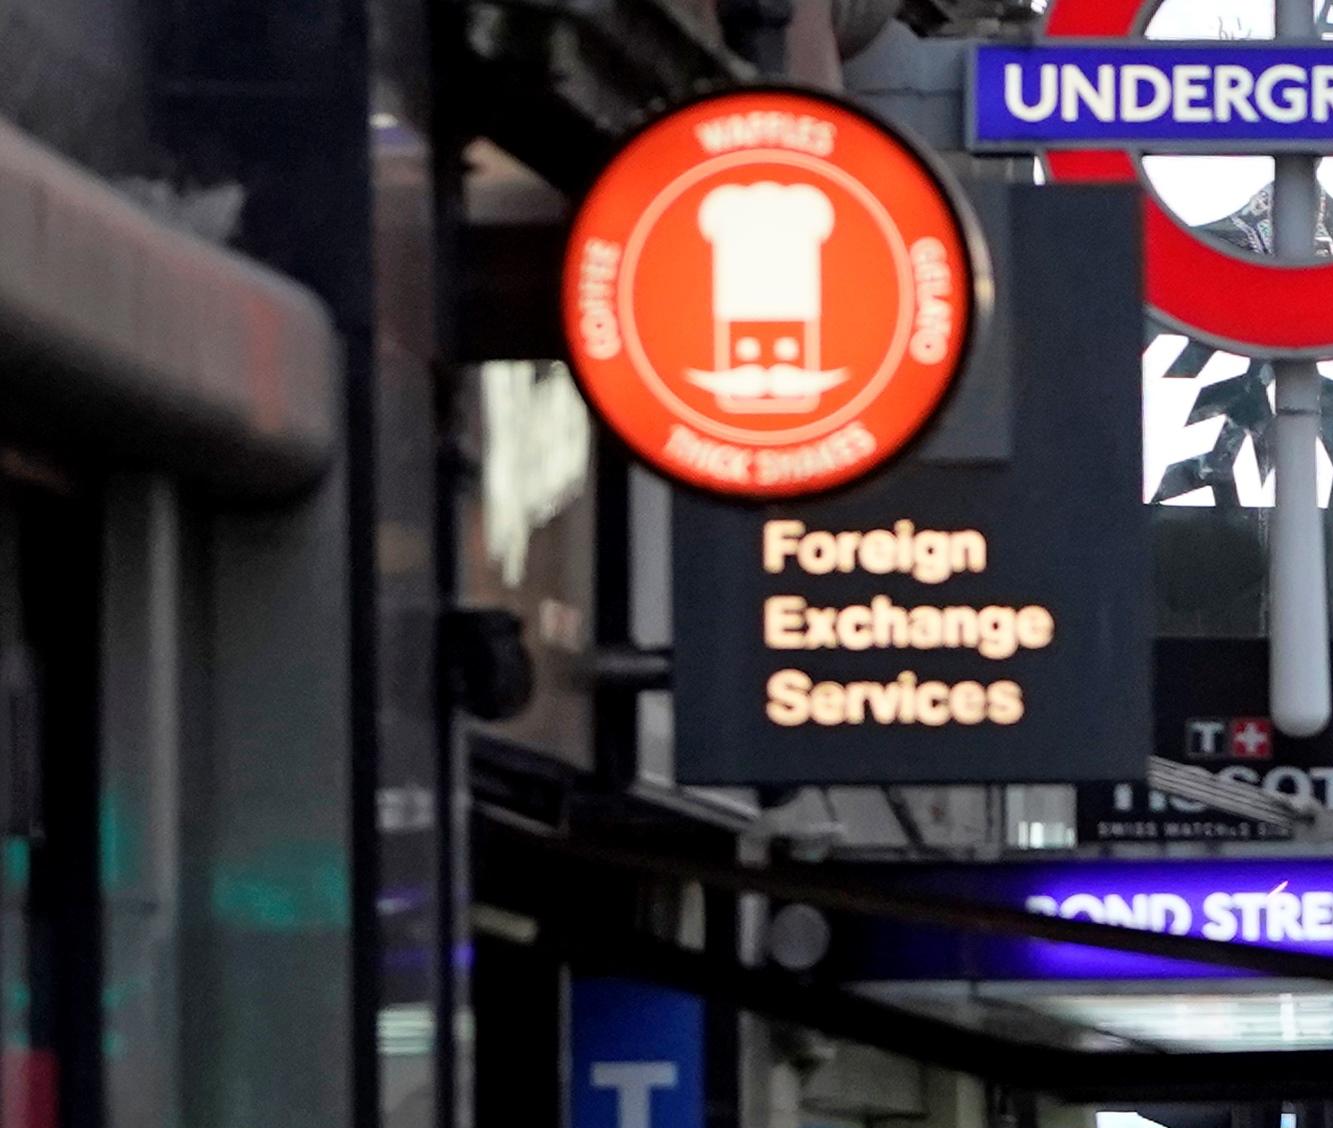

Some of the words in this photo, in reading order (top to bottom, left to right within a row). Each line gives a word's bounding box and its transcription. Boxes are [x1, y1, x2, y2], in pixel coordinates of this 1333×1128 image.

[763, 519, 987, 583] Foreign
[763, 595, 1054, 660] Exchange
[765, 669, 1024, 726] Services
